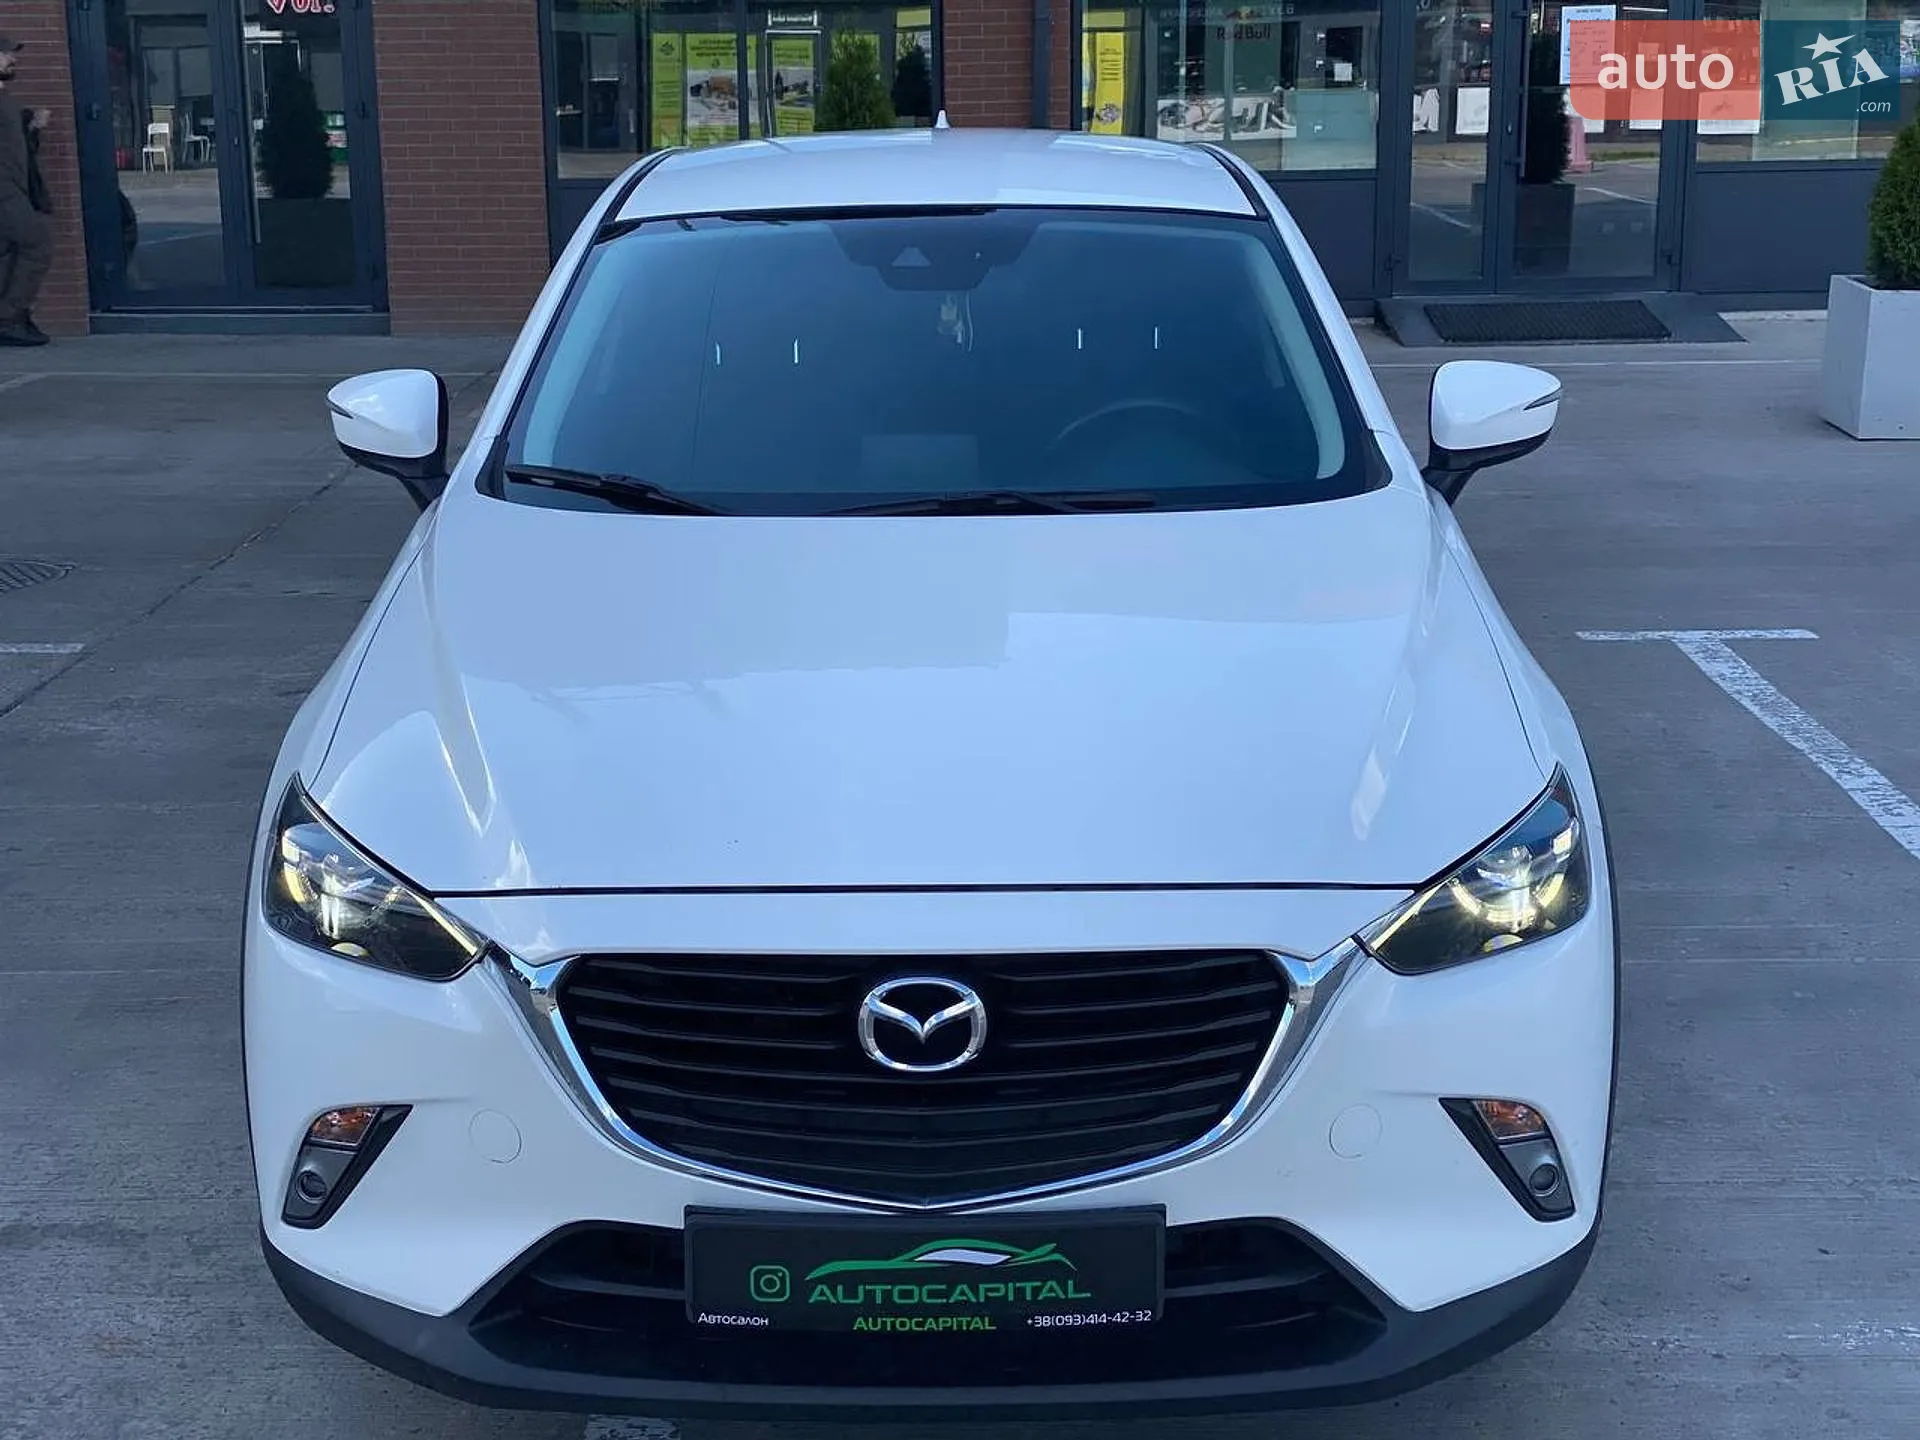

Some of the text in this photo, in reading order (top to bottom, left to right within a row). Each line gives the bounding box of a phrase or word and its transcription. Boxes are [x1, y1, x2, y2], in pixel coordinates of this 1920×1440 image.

[1216, 23, 1271, 40] Rd Bull
[808, 1279, 1092, 1306] AUTOCAPITAL
[697, 1311, 770, 1328] Автосалон
[853, 1316, 998, 1333] AUTOCAPITAL
[1025, 1310, 1153, 1328] +38(093)414-42-32
